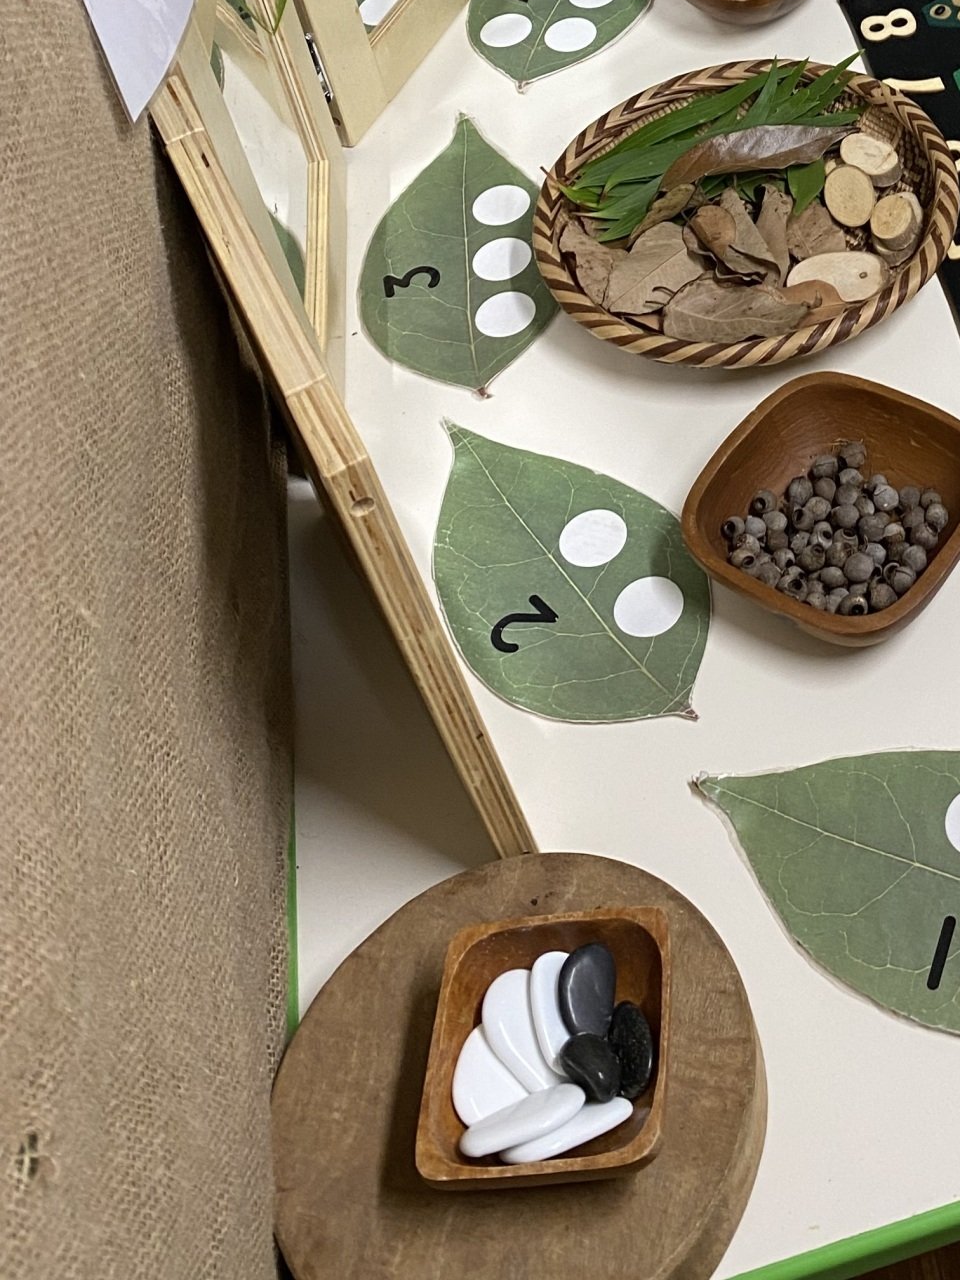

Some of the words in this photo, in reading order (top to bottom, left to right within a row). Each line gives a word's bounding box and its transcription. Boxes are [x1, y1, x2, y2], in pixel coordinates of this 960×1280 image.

[860, 8, 917, 41] 8
[383, 264, 441, 298] 3
[490, 594, 559, 653] 2
[926, 915, 957, 991] 1
